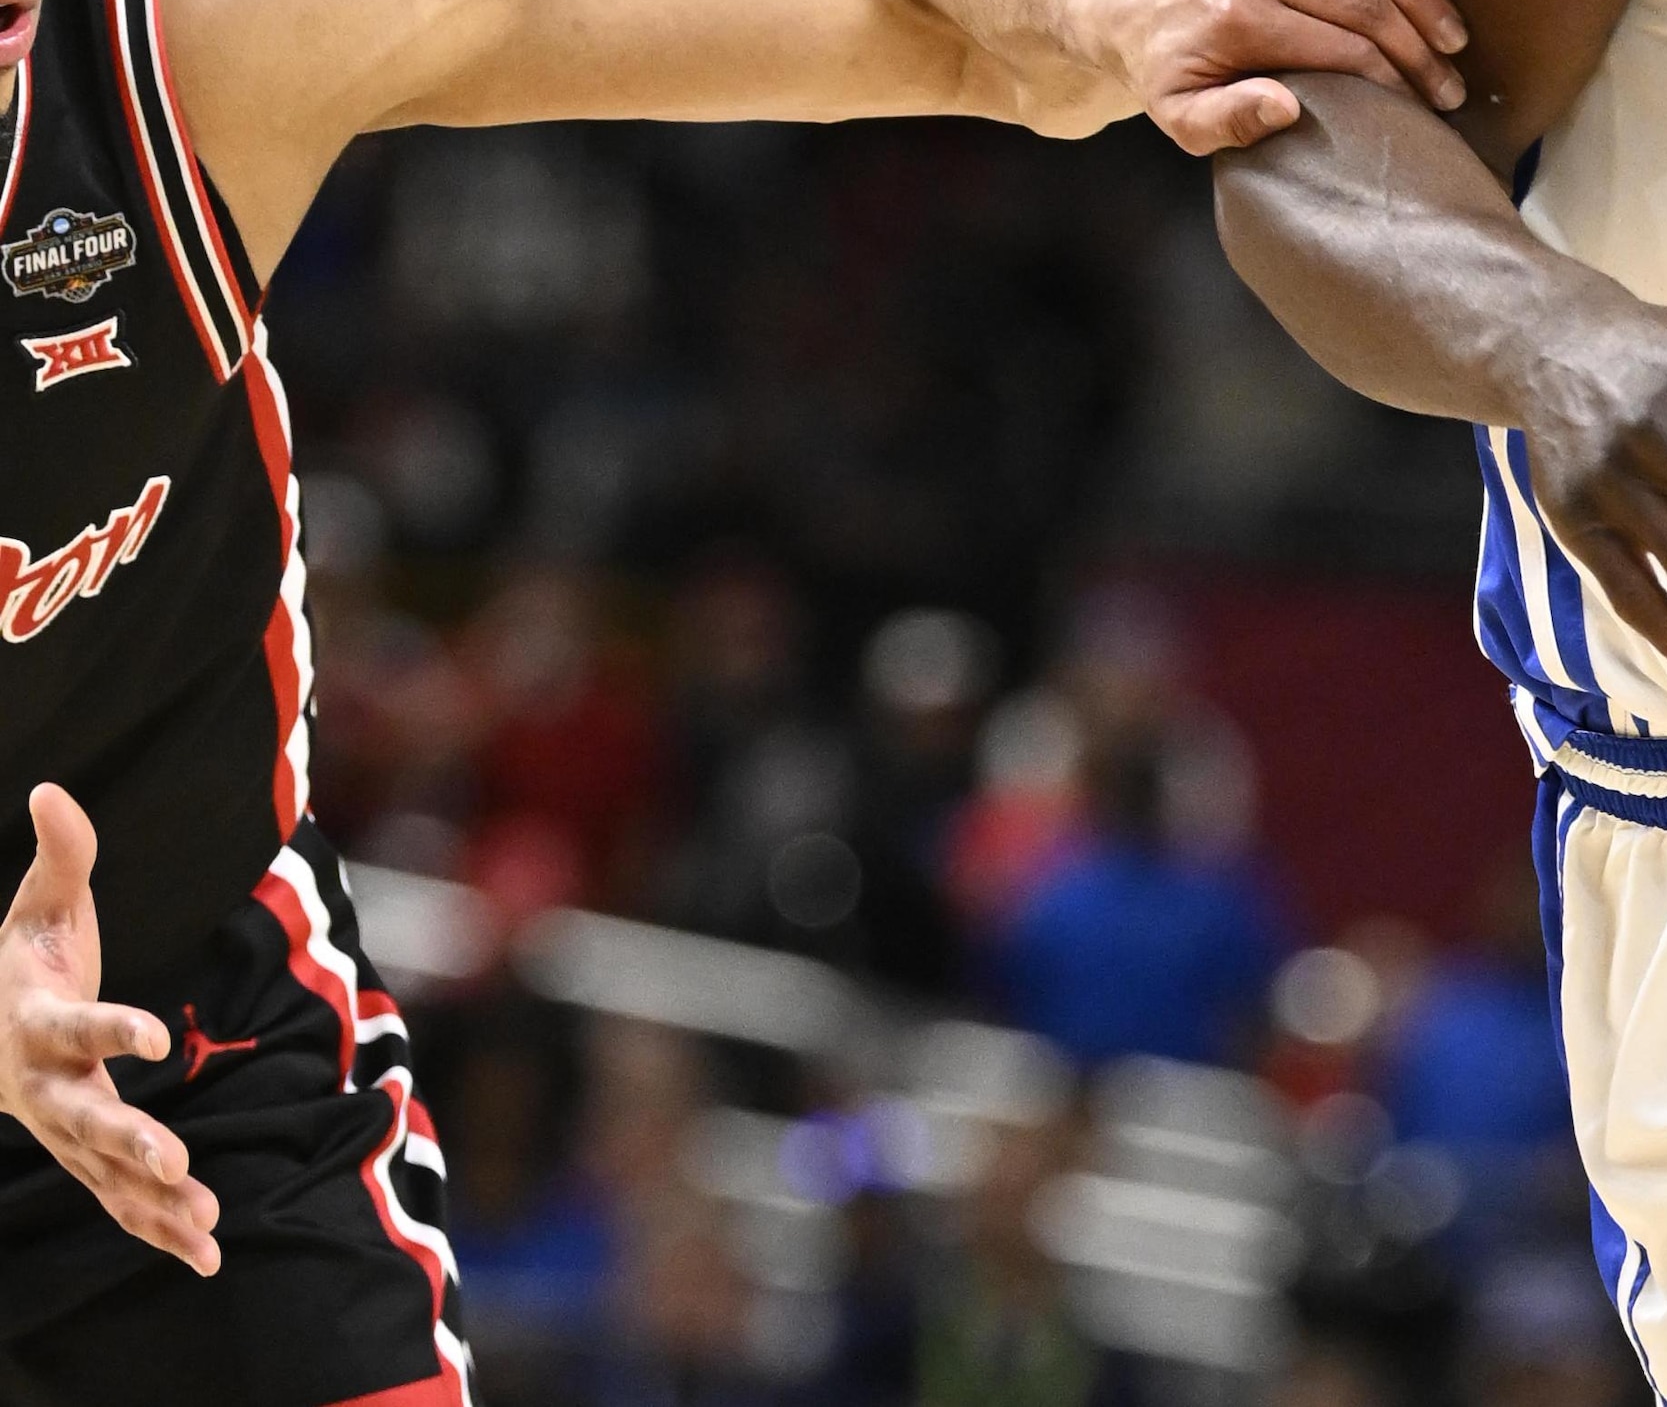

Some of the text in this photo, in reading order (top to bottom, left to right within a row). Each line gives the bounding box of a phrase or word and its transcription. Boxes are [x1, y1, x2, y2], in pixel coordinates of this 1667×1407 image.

[13, 244, 71, 278] FINAL
[72, 227, 129, 261] FOUR
[32, 327, 121, 382] XII
